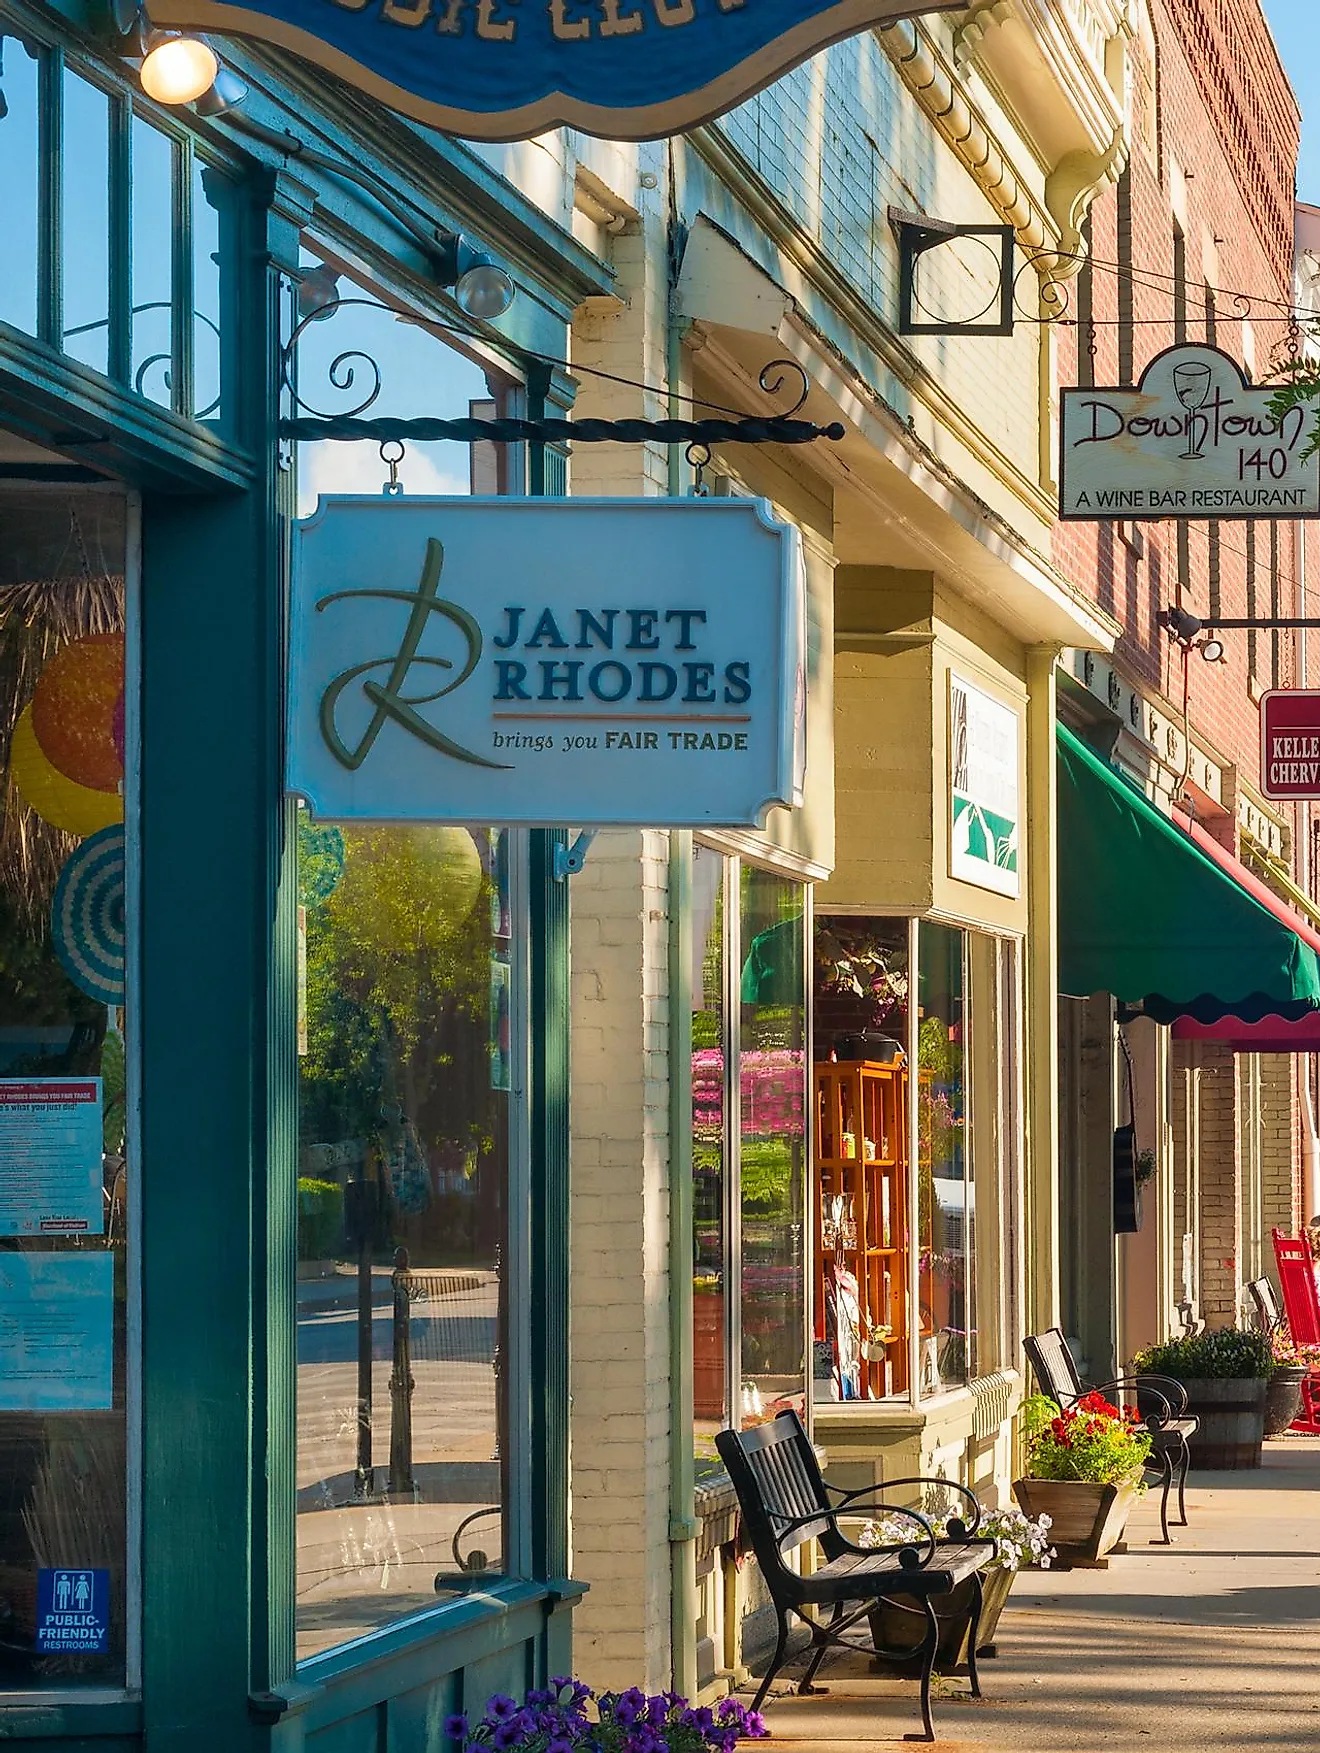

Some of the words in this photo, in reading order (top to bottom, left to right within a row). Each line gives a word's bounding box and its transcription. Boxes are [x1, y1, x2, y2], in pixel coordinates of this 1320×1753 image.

[1074, 386, 1304, 451] Downtown
[1238, 448, 1287, 480] 140
[1076, 491, 1091, 507] A
[1096, 491, 1143, 507] WINE
[1150, 490, 1186, 506] BAR
[1192, 489, 1307, 506] RESTAURANT
[492, 607, 707, 650] JANET
[492, 660, 752, 704] RHODES
[492, 731, 554, 752] brings
[562, 735, 599, 752] you
[605, 732, 659, 750] FAIR
[668, 732, 748, 751] TRADE
[45, 1615, 100, 1626] PUBLIC-
[39, 1628, 105, 1639] FRIENDLY
[43, 1641, 100, 1649] RESTROOMS
